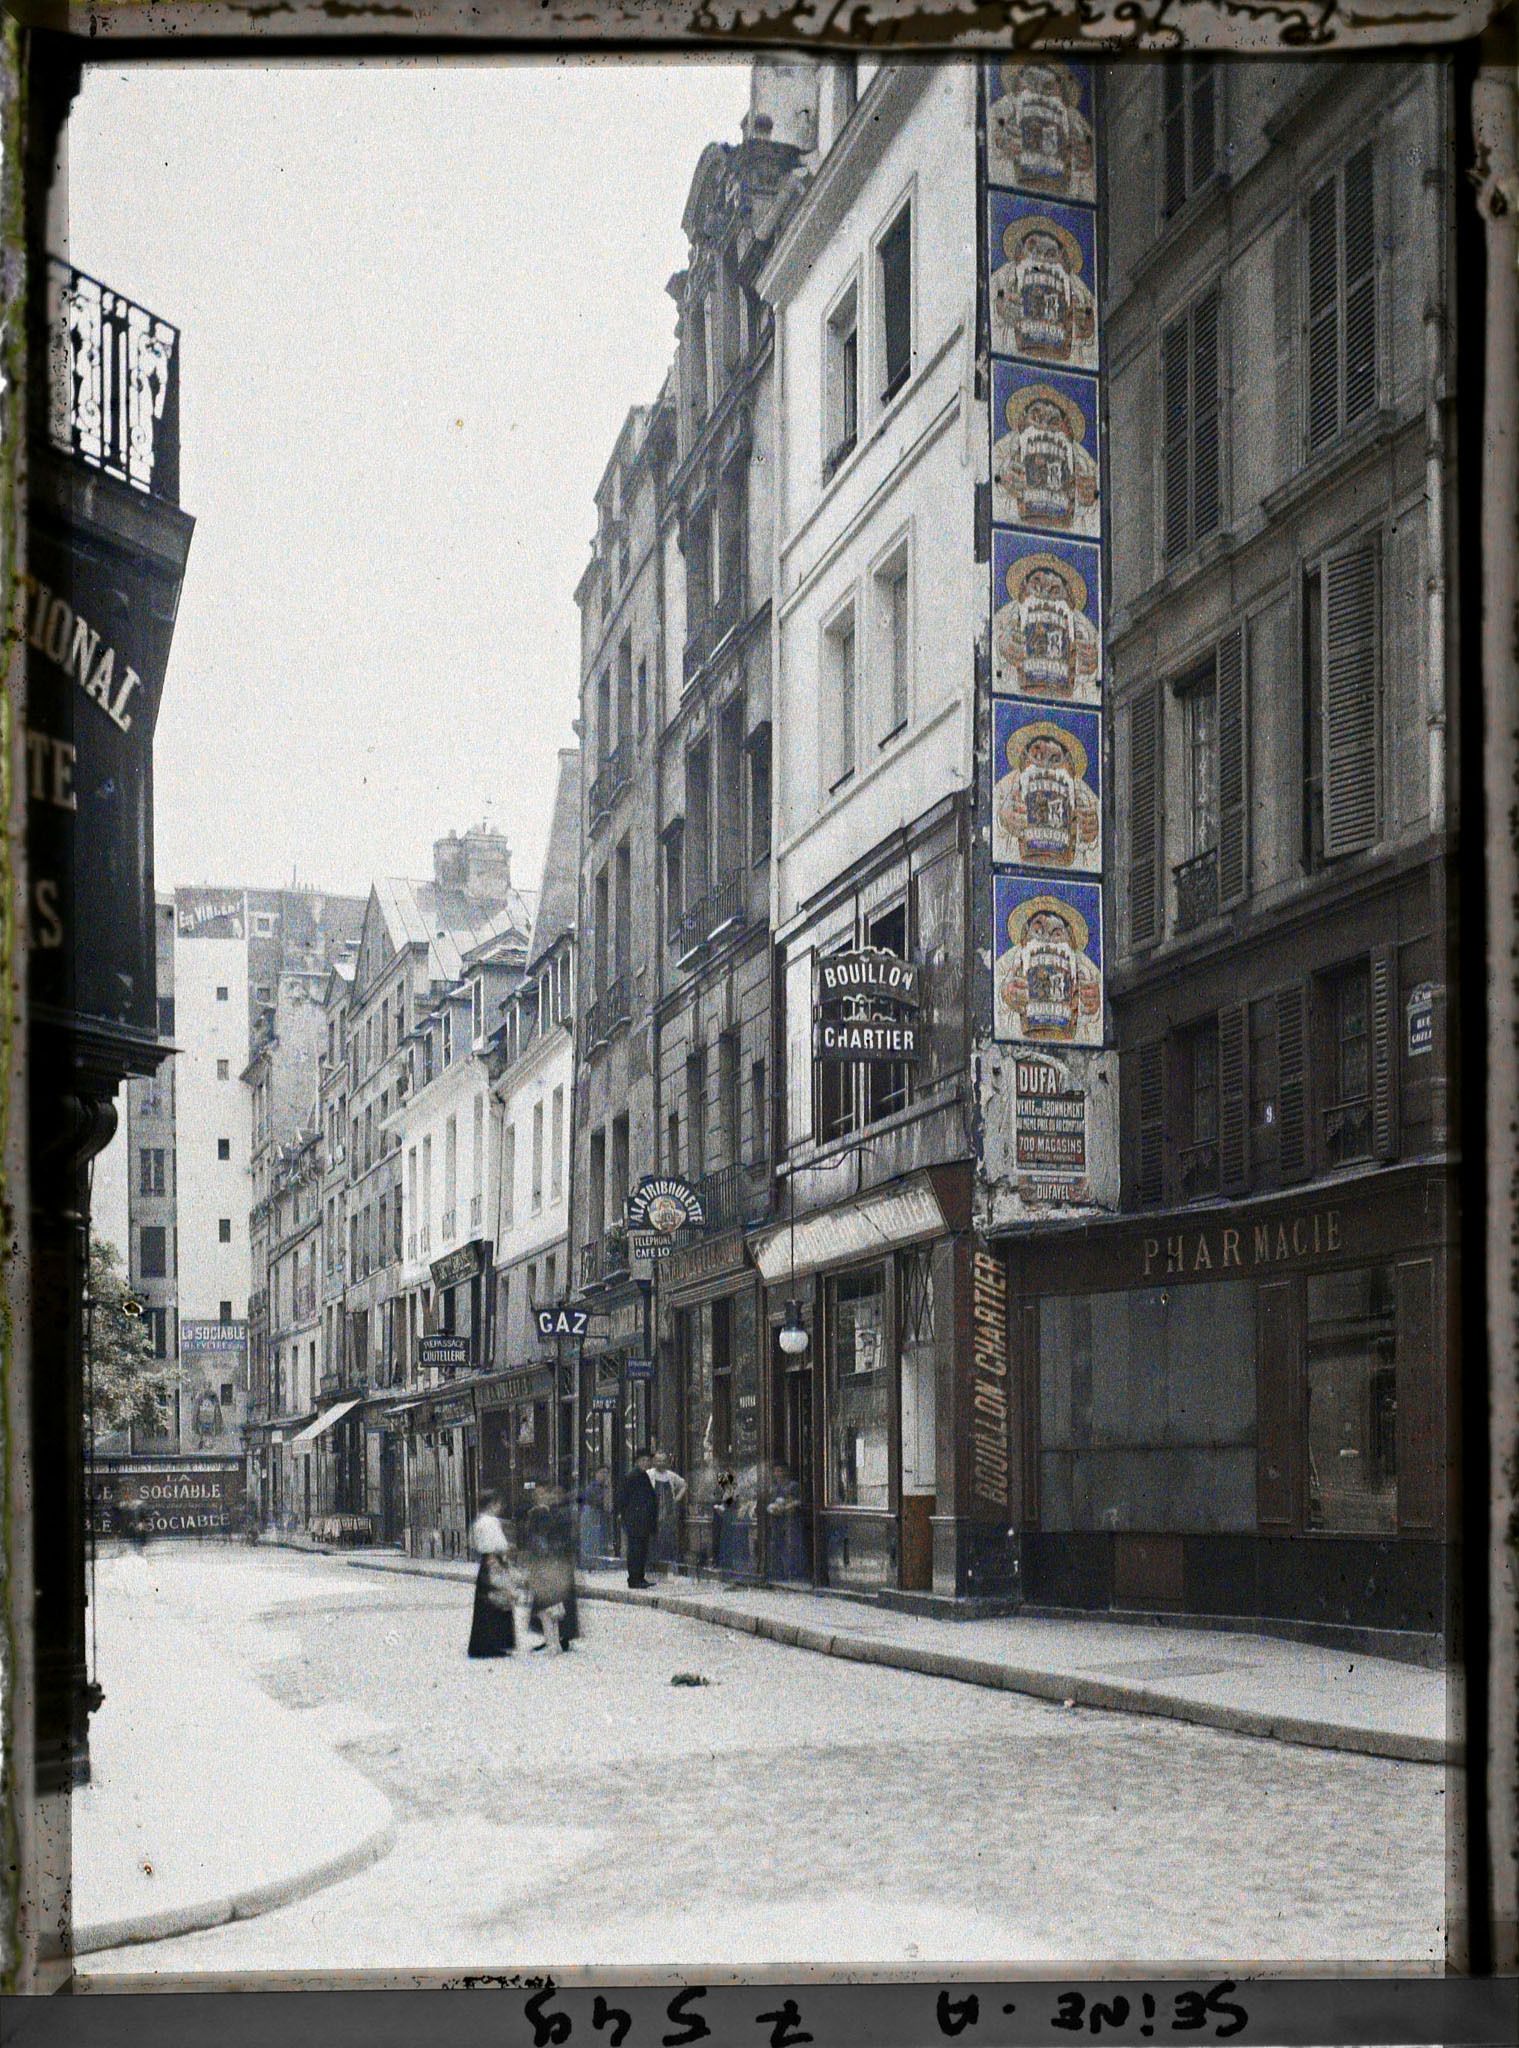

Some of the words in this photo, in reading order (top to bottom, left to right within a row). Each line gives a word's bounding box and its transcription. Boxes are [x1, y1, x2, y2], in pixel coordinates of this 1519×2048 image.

[824, 962, 913, 991] BOUILLON
[824, 1026, 914, 1051] CHARTIER
[1019, 1136, 1035, 1152] 700
[1037, 1137, 1082, 1154] MAGASINS
[1036, 1183, 1070, 1200] DUFAYEL
[1144, 1210, 1343, 1276] PHARMACIE
[538, 1311, 589, 1335] GAZ
[974, 1250, 1007, 1377] CHARTIER
[195, 1325, 246, 1340] SOCIABLE
[422, 1349, 467, 1362] COUTELLERIE
[974, 1378, 1008, 1504] BOUILLON
[139, 1483, 222, 1500] SOCIABLE
